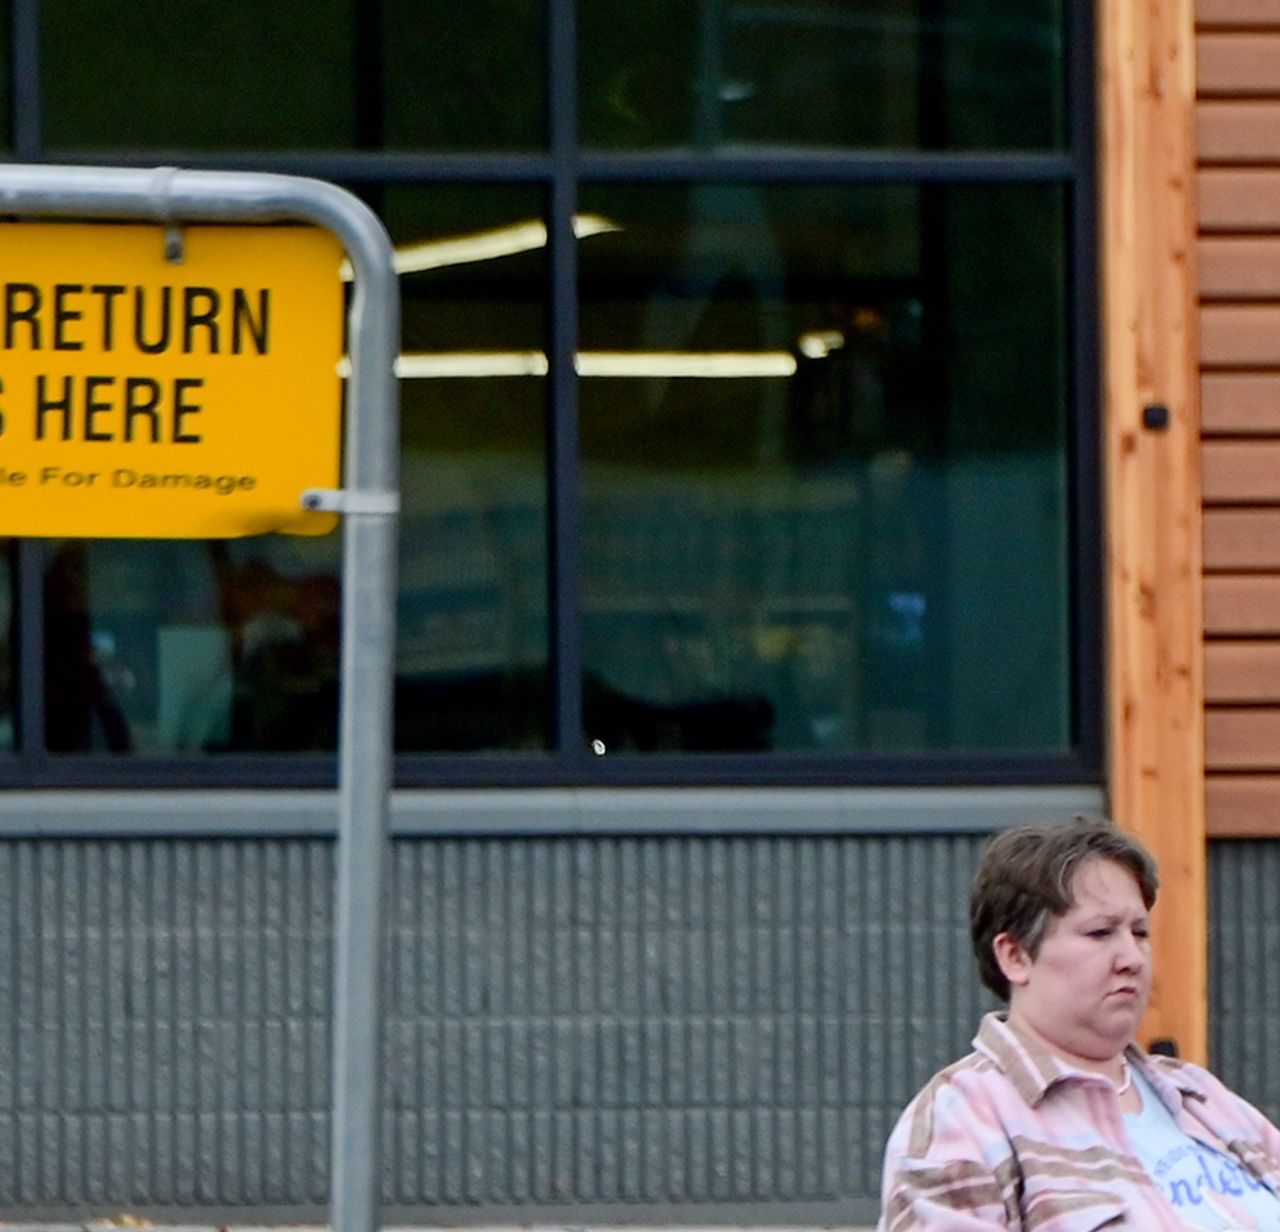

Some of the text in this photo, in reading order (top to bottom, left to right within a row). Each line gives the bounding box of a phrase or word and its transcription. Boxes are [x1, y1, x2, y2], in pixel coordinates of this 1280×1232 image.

[4, 282, 270, 355] RETURN
[35, 375, 204, 444] HERE
[39, 466, 100, 487] For
[112, 468, 258, 496] Damage
